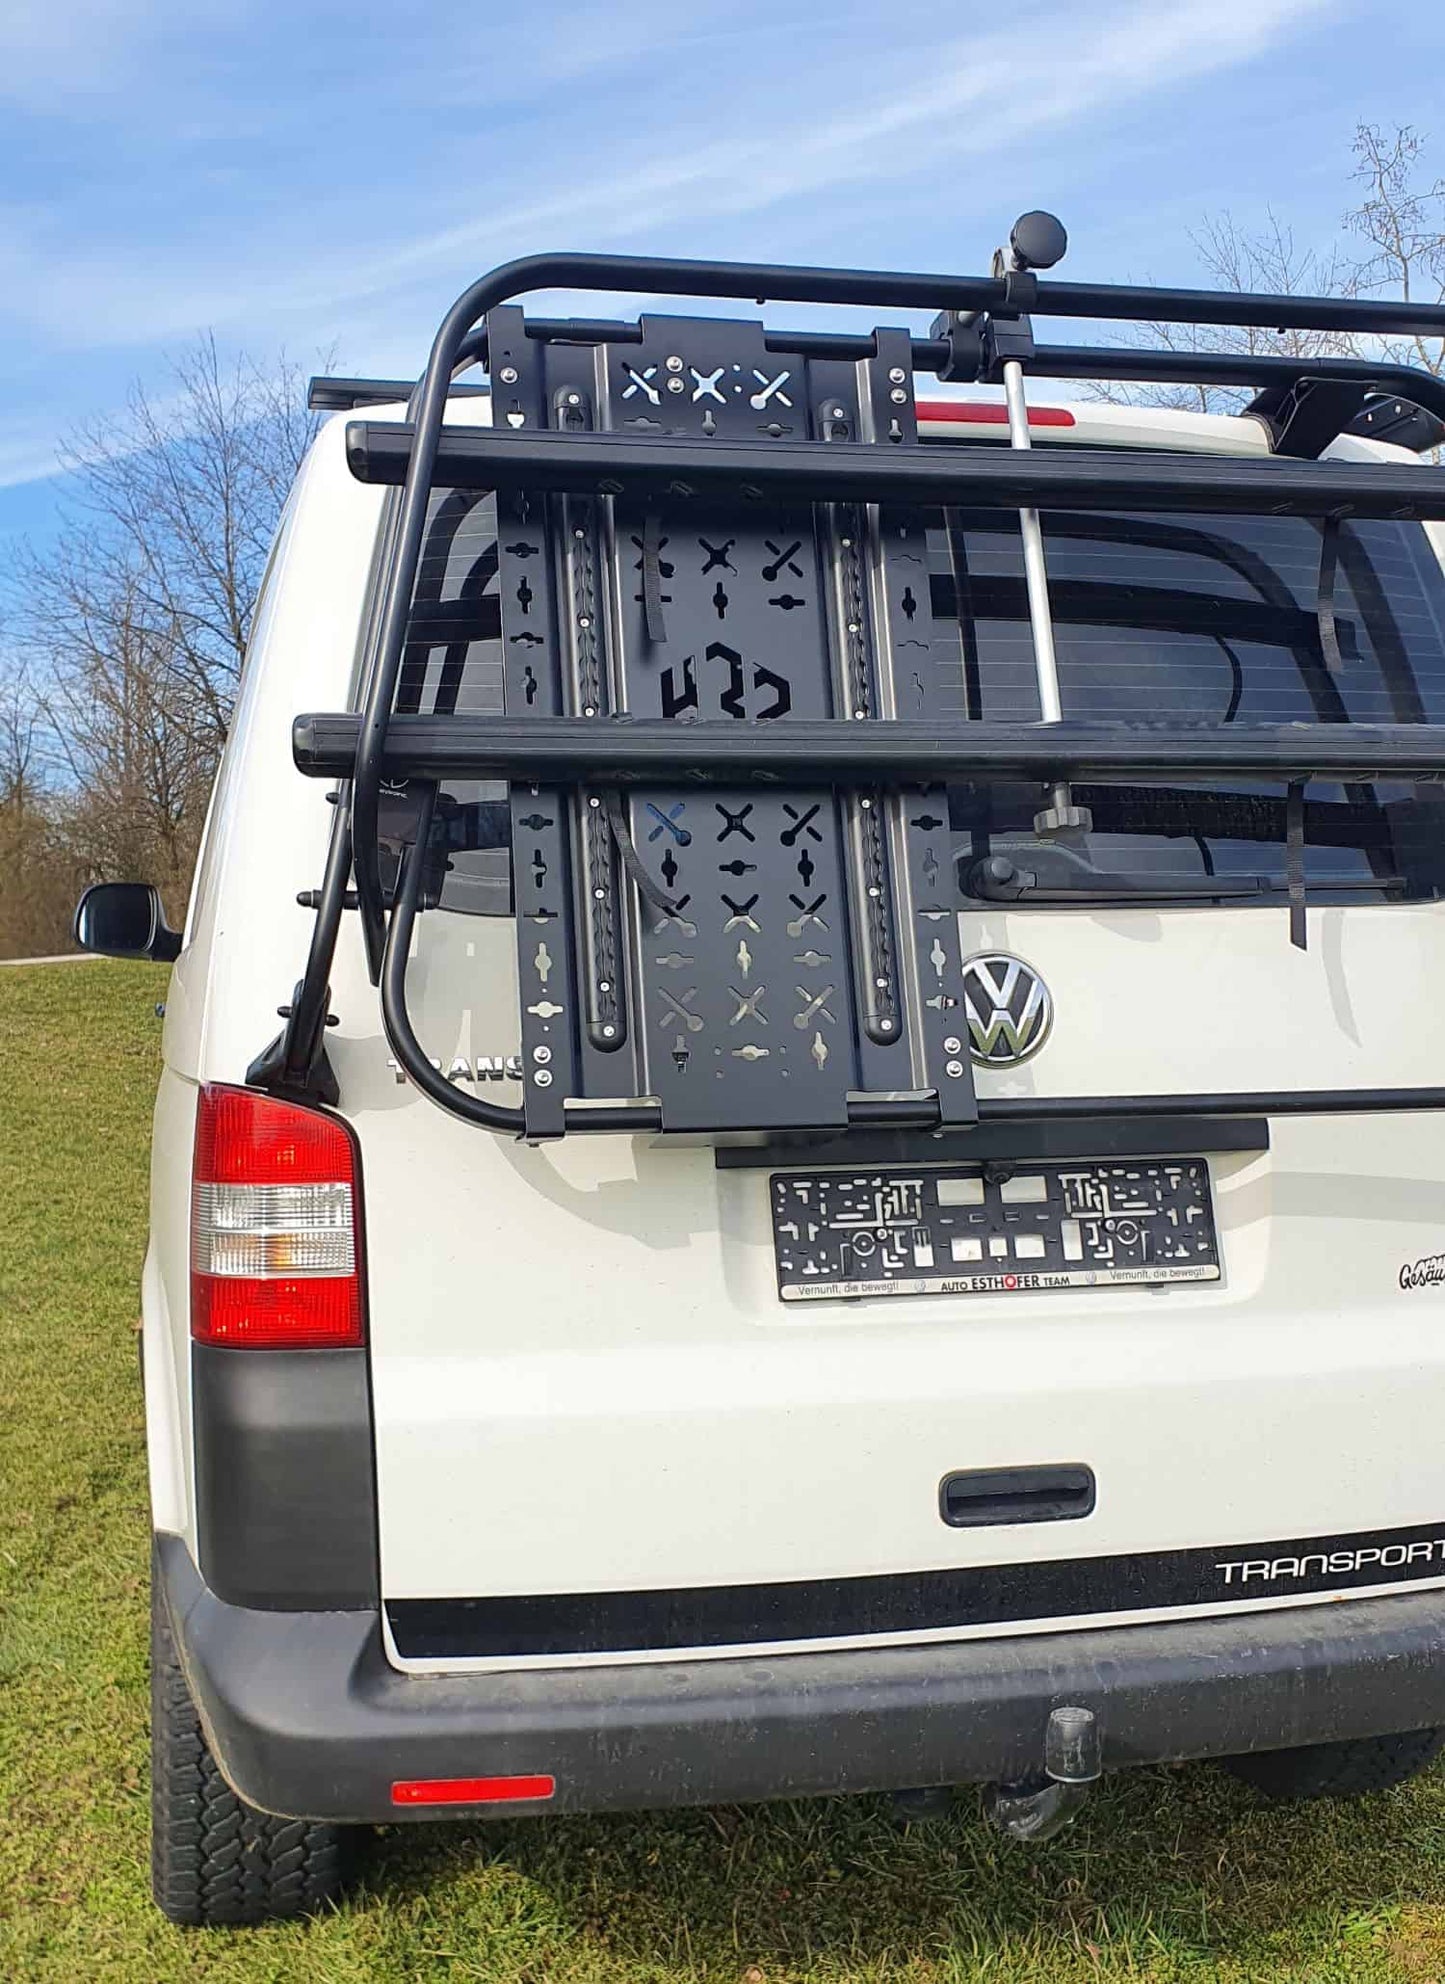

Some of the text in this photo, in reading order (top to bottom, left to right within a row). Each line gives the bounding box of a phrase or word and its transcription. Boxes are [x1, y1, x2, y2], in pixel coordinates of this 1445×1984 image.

[963, 958, 1045, 1060] VW
[386, 1056, 523, 1084] TANS
[941, 1274, 1071, 1292] AUTO ESTHOFER TEAM
[1110, 1266, 1205, 1281] Vernunft, die bewegt!
[1399, 1263, 1445, 1289] Gesäu
[798, 1280, 899, 1296] Vernunft, die bewegt!
